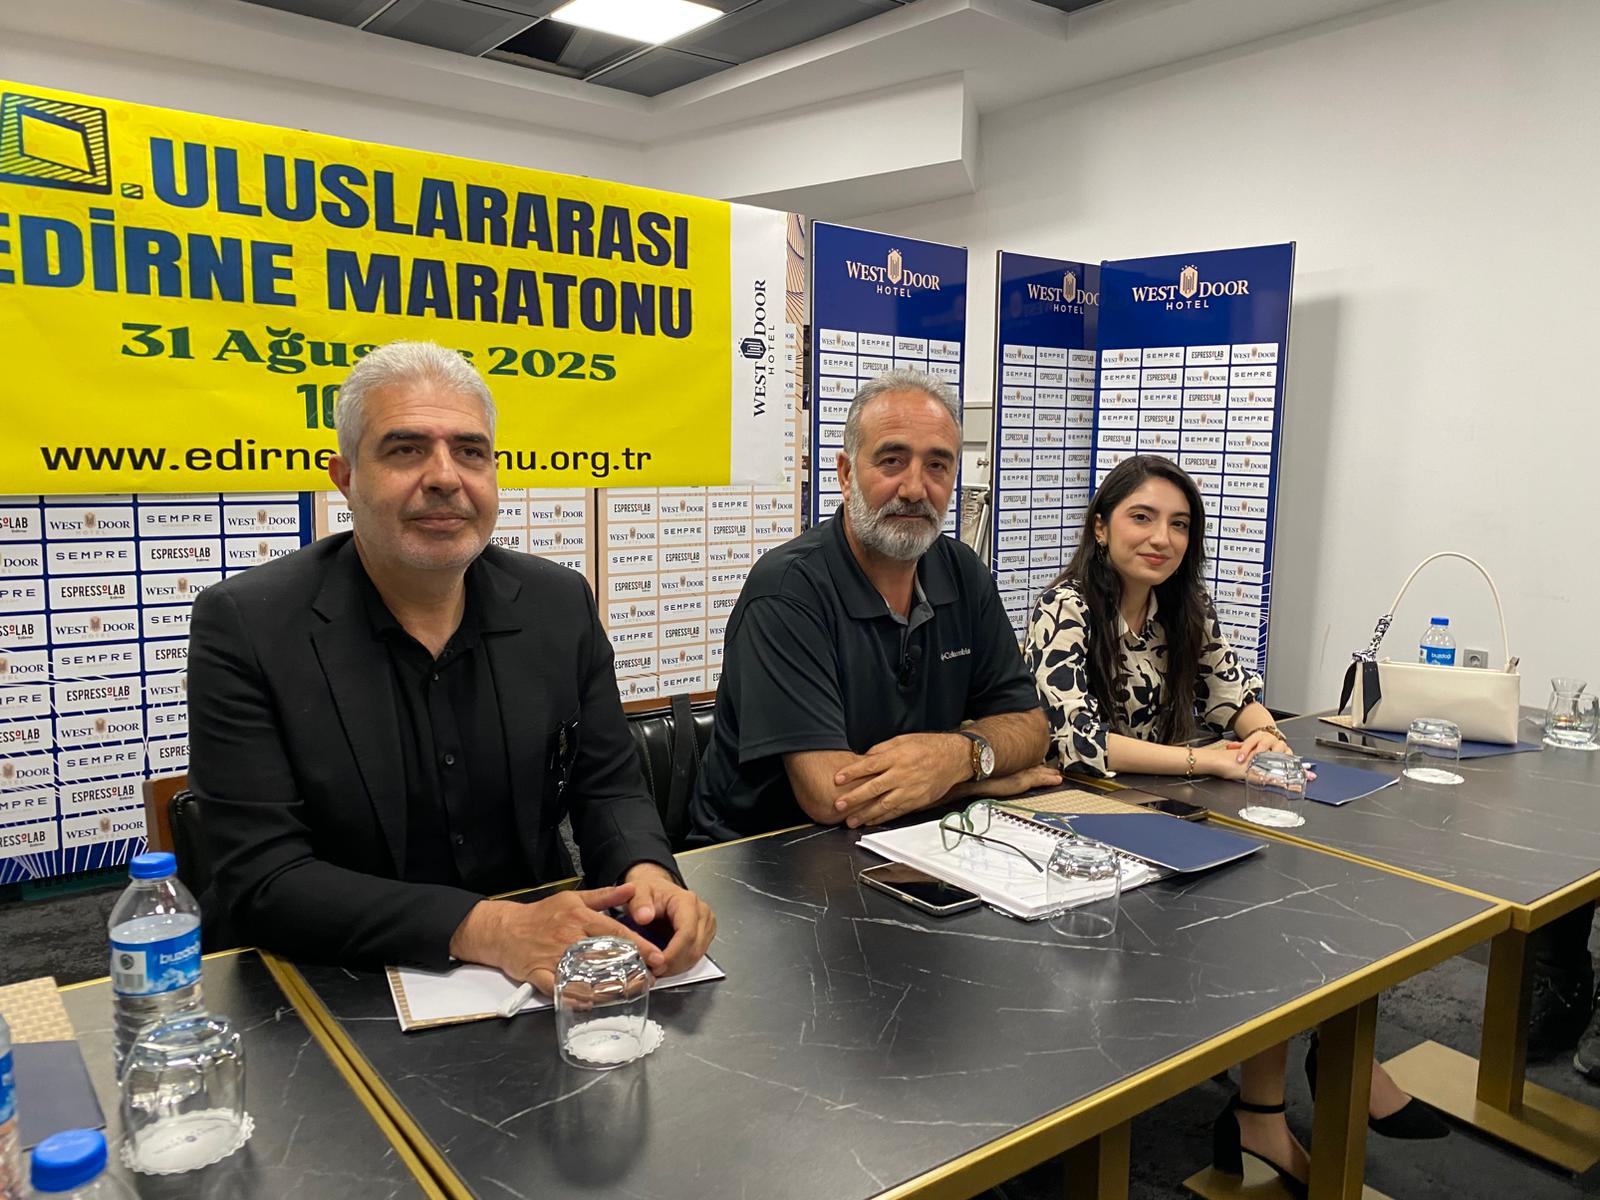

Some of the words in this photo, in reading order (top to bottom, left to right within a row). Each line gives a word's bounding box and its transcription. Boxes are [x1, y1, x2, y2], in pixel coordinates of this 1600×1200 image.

[150, 136, 688, 269] ULUSLARARASI
[846, 260, 887, 283] WEST
[903, 270, 940, 290] DOOR
[326, 248, 692, 339] MARATONU
[876, 285, 912, 298] HOTEL
[1028, 284, 1062, 302] WEST
[1077, 289, 1099, 306] DOO
[1132, 285, 1178, 302] WEST
[1199, 280, 1249, 297] DOOR
[753, 279, 767, 336] DOOR
[1054, 304, 1085, 315] HOTEL
[1166, 300, 1209, 311] HOTEL
[121, 322, 195, 359] 31
[488, 346, 616, 381] 2025
[753, 361, 767, 417] WEST
[1232, 414, 1269, 422] SEMPRE
[40, 439, 652, 478] www.edirnenu.org.tr
[1250, 461, 1268, 469] DOOR
[1228, 480, 1265, 488] SEMPRE
[687, 504, 704, 512] DOOR
[778, 502, 793, 510] DOOR
[1247, 505, 1265, 513] DOOR
[146, 514, 213, 523] SEMPRE
[532, 511, 553, 519] WEST
[562, 510, 583, 518] DOOR
[50, 520, 83, 530] WEST
[98, 520, 131, 529] DOOR
[228, 517, 257, 526] WEST
[268, 516, 296, 525] DOOR
[636, 532, 656, 540] DOOR
[1246, 527, 1264, 535] DOOR
[489, 536, 520, 546] RESSOLAB
[532, 537, 553, 546] WEST
[562, 536, 584, 545] DOOR
[1224, 544, 1261, 553] SEMPRE
[56, 550, 128, 560] SEMPRE
[229, 550, 257, 559] WEST
[612, 555, 653, 564] SEMPRE
[710, 552, 727, 561] WEST
[734, 552, 750, 560] DOOR
[4, 558, 39, 567] DOOR
[712, 574, 747, 582] SEMPRE
[1242, 569, 1261, 577] DOOR
[662, 580, 679, 589] WEST
[687, 580, 704, 588] DOOR
[0, 588, 36, 598] PRE
[146, 587, 177, 596] WEST
[189, 584, 211, 595] DO
[1241, 591, 1260, 600] DOOR
[664, 602, 702, 612] SEMPRE
[714, 599, 736, 609] ESPRESS
[610, 612, 629, 620] WEST
[637, 610, 656, 618] DOOR
[1219, 608, 1257, 618] SEMPRE
[150, 615, 192, 624] SEMP
[0, 623, 34, 636] SSOLAB
[56, 626, 88, 635] WEST
[103, 622, 136, 632] DOOR
[710, 627, 725, 635] WEST
[613, 632, 654, 642] SEMPRE
[1239, 633, 1257, 641] DOOR
[61, 652, 133, 665] SEMPRE
[156, 648, 188, 660] ESPRES
[662, 656, 679, 665] WEST
[686, 655, 704, 663] DOOR
[10, 664, 44, 674] DOOR
[664, 676, 702, 687] SEMPRE
[150, 686, 180, 695] WEST
[636, 686, 656, 694] DOOR
[61, 728, 93, 738] WEST
[108, 722, 139, 733] DOOR
[0, 728, 40, 743] ESSOLAB
[66, 752, 137, 768] SEMPRE
[16, 767, 50, 779] DOOR
[0, 796, 48, 810] MPRE
[66, 828, 99, 840] WEST
[112, 820, 144, 832] DOOR
[0, 830, 46, 848] RESSOLAB
